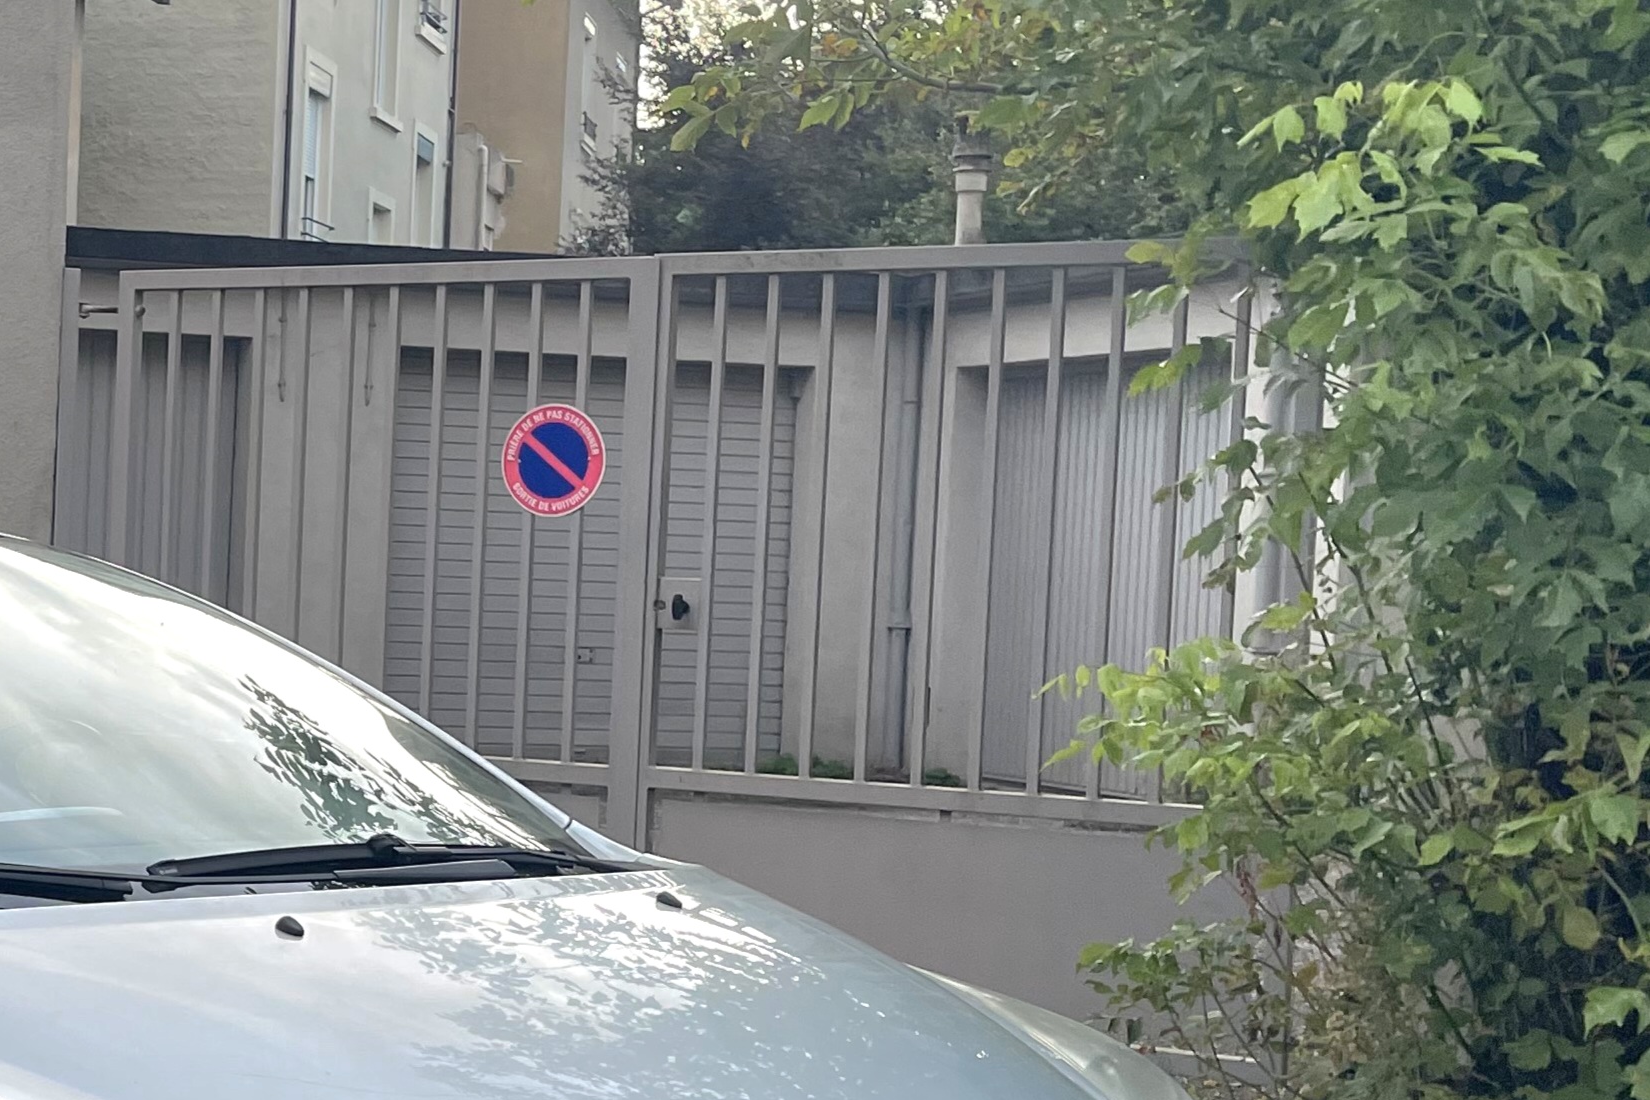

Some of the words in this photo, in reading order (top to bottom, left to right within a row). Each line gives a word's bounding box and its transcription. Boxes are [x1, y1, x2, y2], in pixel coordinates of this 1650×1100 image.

[521, 418, 534, 431] DE
[532, 412, 545, 423] NE
[546, 410, 563, 419] PAS
[563, 411, 600, 456] STATIONNER
[512, 482, 538, 508] SORTIE
[538, 501, 550, 511] DE
[551, 485, 589, 511] VOITURES
